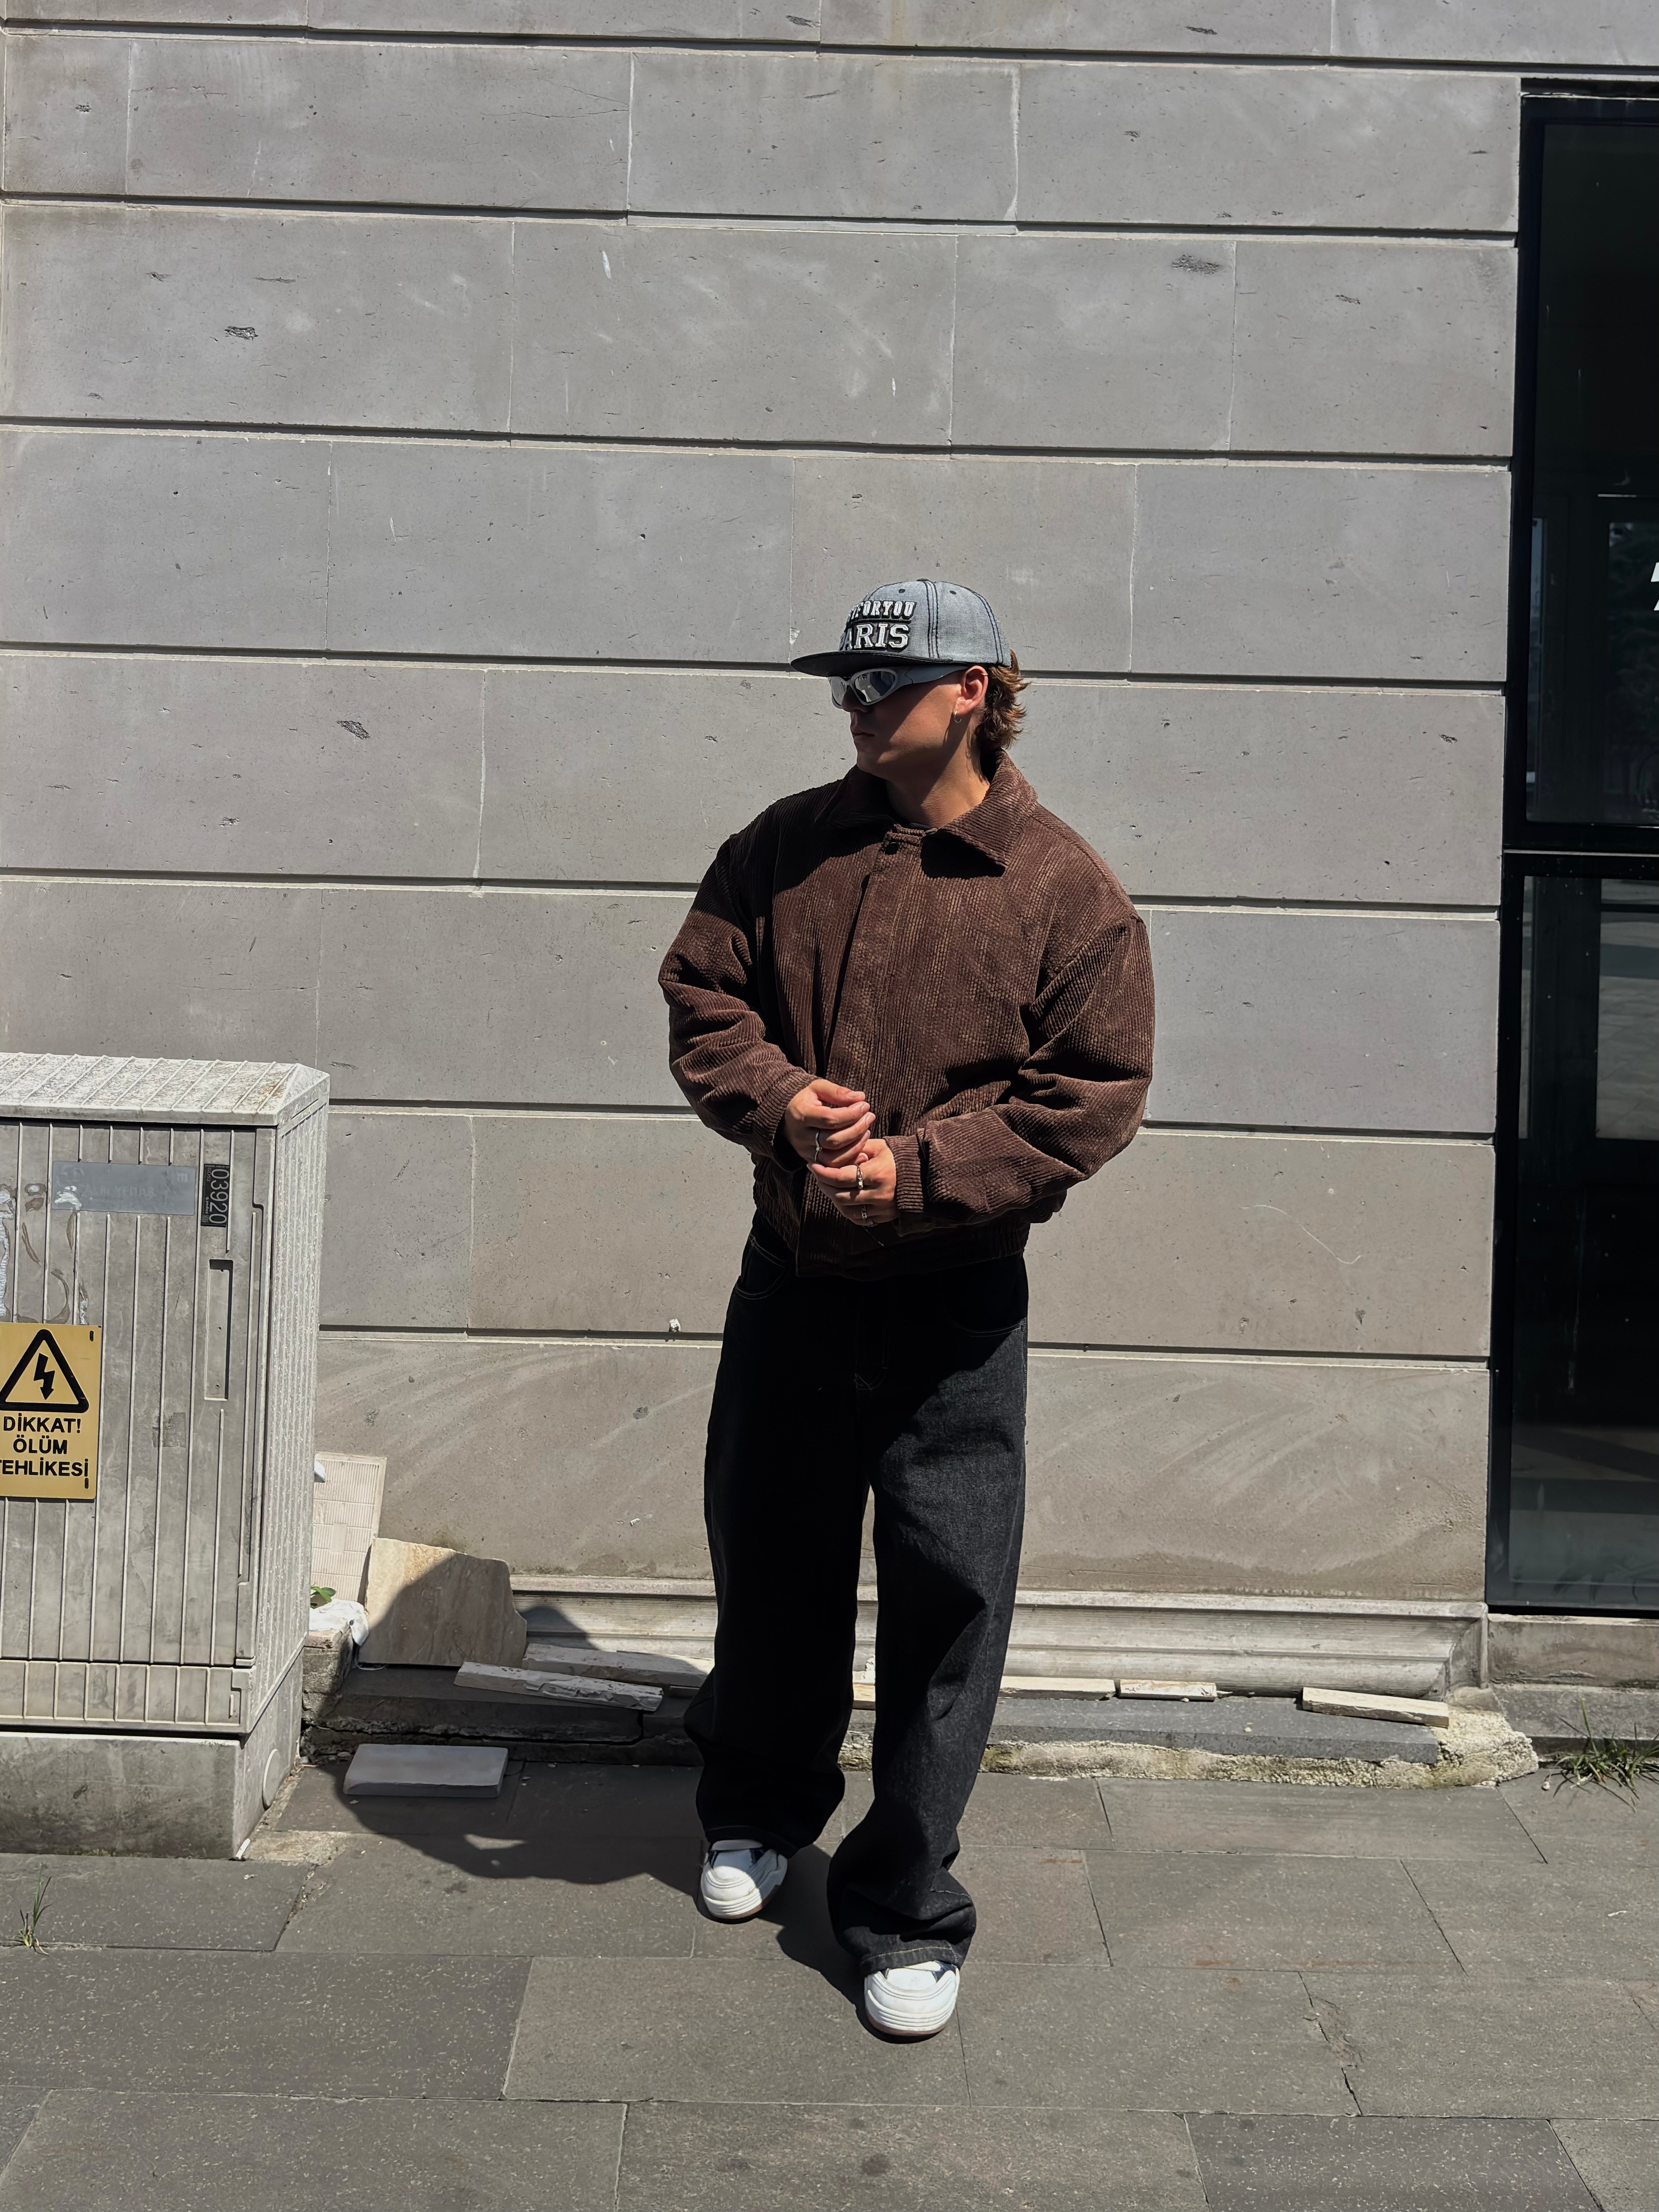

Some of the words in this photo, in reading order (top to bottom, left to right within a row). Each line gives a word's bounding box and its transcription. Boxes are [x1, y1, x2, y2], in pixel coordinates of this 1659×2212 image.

[209, 1169, 229, 1223] 03920
[4, 1413, 81, 1434] DİKKAT!
[13, 1435, 67, 1454] ÖLÜM
[0, 1457, 89, 1477] EHLİKESİ
